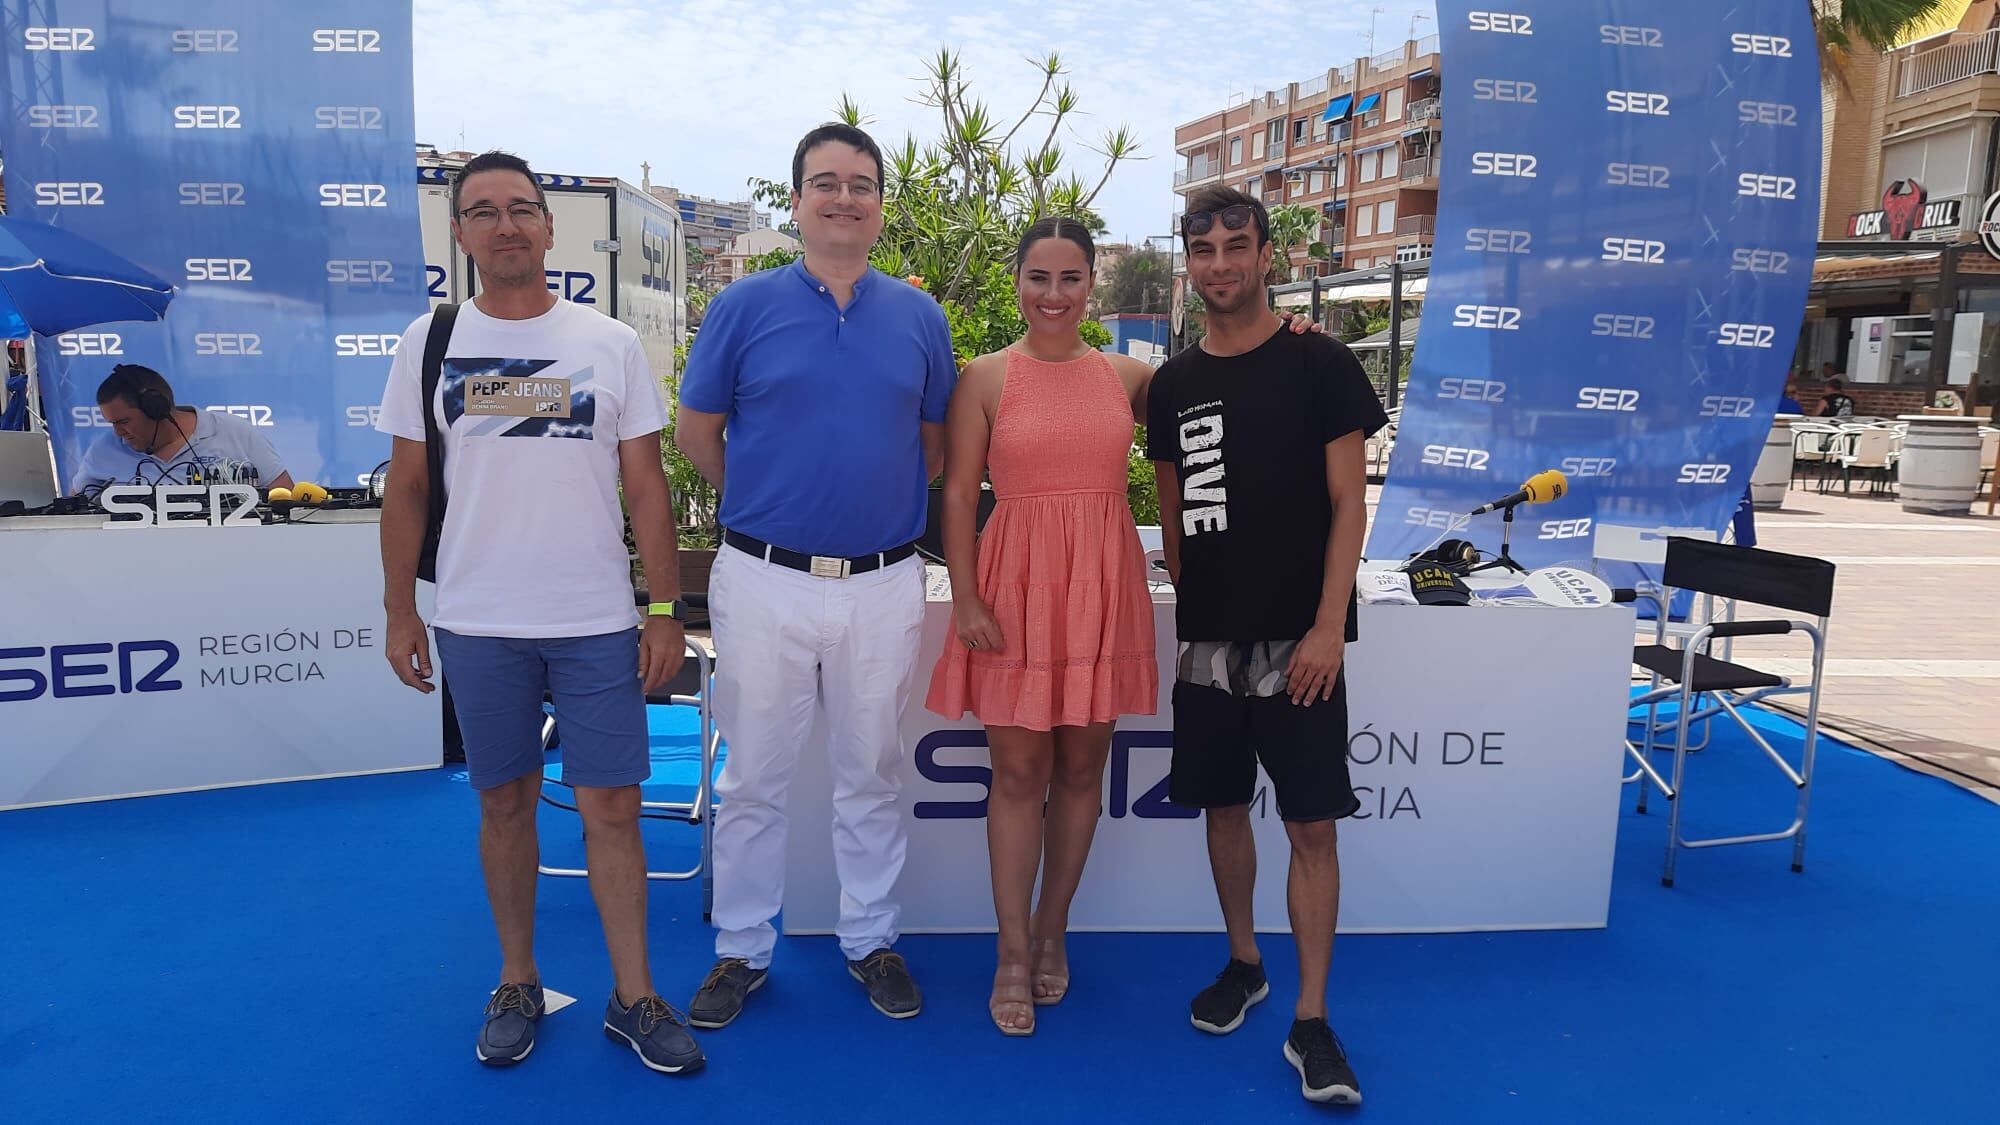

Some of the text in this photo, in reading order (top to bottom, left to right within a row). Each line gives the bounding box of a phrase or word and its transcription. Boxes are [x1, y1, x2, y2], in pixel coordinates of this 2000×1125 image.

[1469, 11, 1533, 35] SER
[25, 27, 95, 51] SER
[172, 30, 239, 52] SER
[313, 30, 380, 52] SER
[1600, 25, 1663, 47] SER
[1731, 33, 1792, 58] SER
[1473, 78, 1537, 103] SER
[1606, 90, 1669, 116] SER
[1738, 101, 1797, 127] SER
[29, 105, 99, 128] SER
[174, 106, 241, 129] SER
[315, 106, 383, 129] SER
[1471, 152, 1537, 178] SER
[1608, 163, 1670, 189] SER
[35, 182, 104, 205] SER
[179, 183, 246, 206] SER
[320, 184, 387, 207] SER
[1738, 173, 1796, 200] SER
[1848, 202, 1954, 238] ROCK GRILL
[1983, 222, 2000, 232] ROC
[1465, 228, 1532, 254] SER
[1602, 237, 1665, 264] SER
[185, 258, 253, 281] SER
[326, 260, 394, 283] SER
[1731, 248, 1789, 274] SER
[1453, 305, 1521, 330] SER
[1591, 313, 1655, 339] SER
[58, 333, 123, 355] SER
[195, 333, 263, 355] SER
[335, 334, 401, 356] SER
[1717, 323, 1775, 348] SER
[472, 382, 562, 398] PEPE JEANS
[1437, 378, 1506, 402] SER
[1576, 387, 1639, 411] SER
[535, 401, 561, 412] 1973
[1700, 395, 1755, 417] SER
[1421, 444, 1490, 470] SER
[1561, 457, 1616, 477] SER
[1180, 414, 1229, 537] DIVE
[1677, 463, 1731, 484] SER
[101, 485, 262, 529] SER
[1405, 507, 1472, 532] SER
[1538, 517, 1591, 540] SER
[1412, 568, 1452, 582] UCAM
[1556, 570, 1600, 604] UCAM
[0, 628, 373, 701] SER REGIÓN DE
[200, 661, 325, 689] MURCIA
[1443, 731, 1505, 766] DE
